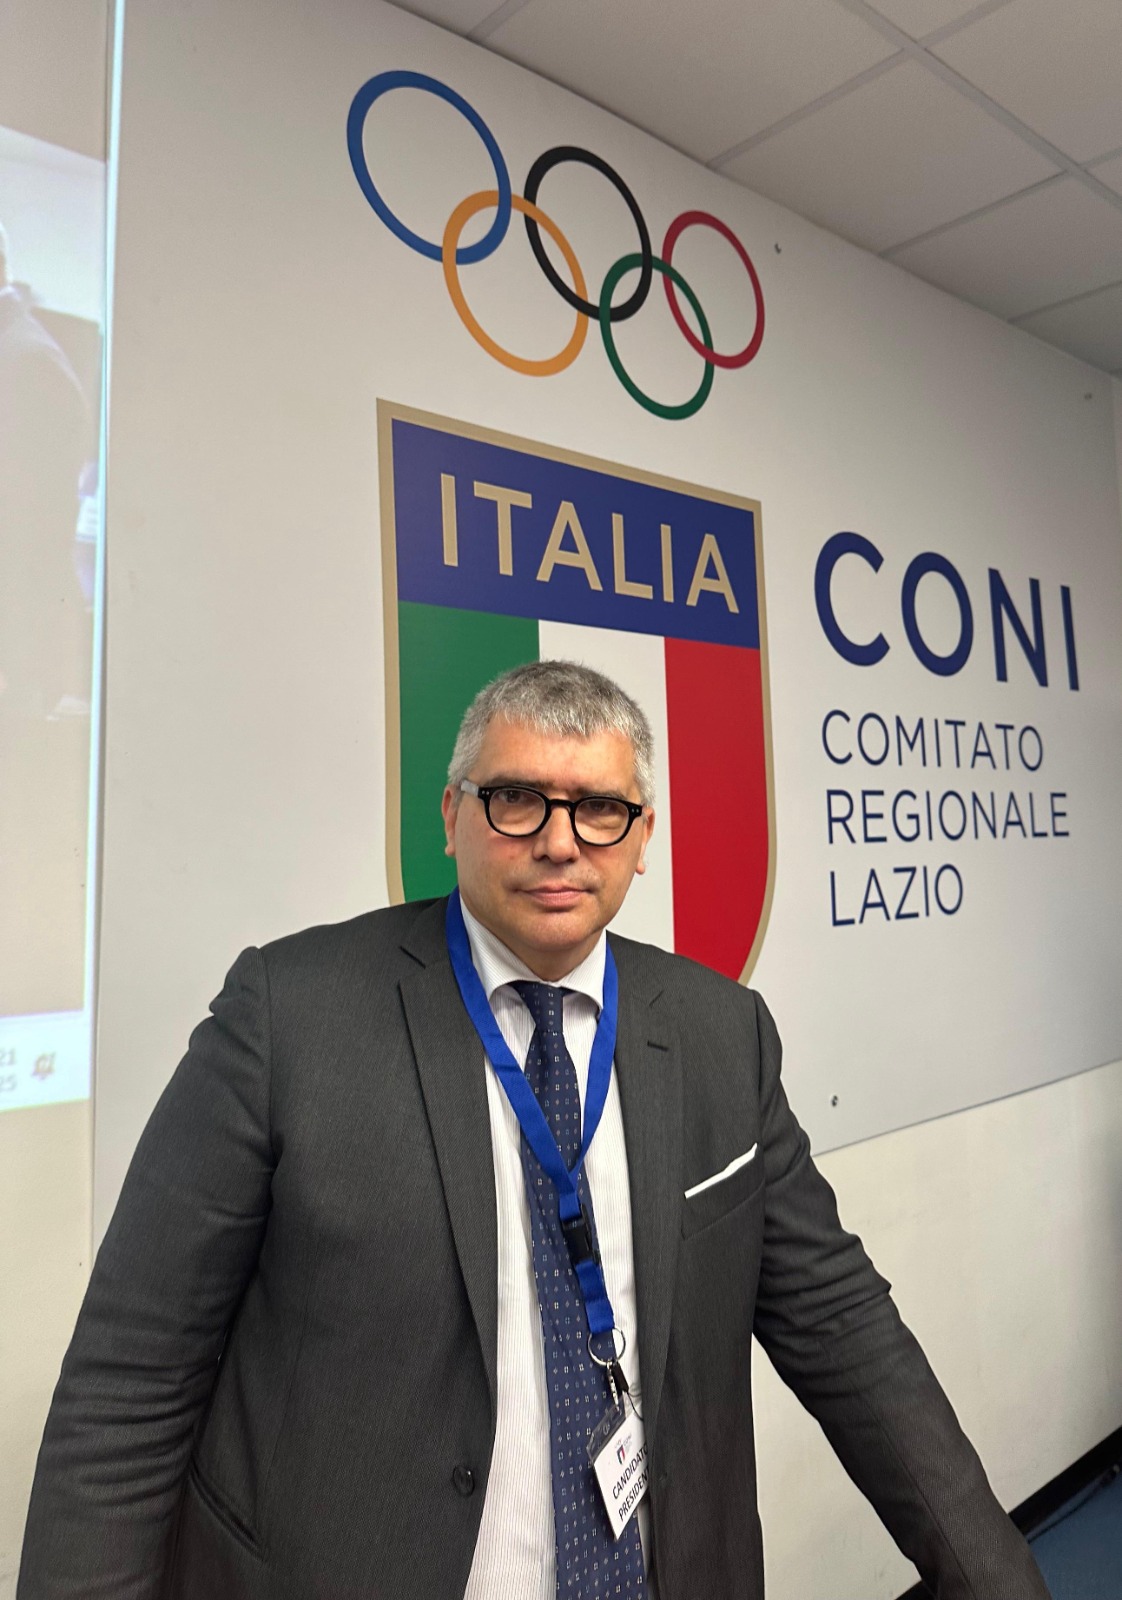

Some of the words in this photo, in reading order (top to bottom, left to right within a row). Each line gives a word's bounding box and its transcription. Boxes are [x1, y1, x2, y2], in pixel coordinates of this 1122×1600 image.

[440, 473, 740, 614] ITALIA
[814, 531, 1080, 692] CONI
[821, 709, 1044, 772] COMITATO
[826, 788, 1070, 845] REGIONALE
[829, 863, 964, 928] LAZIO
